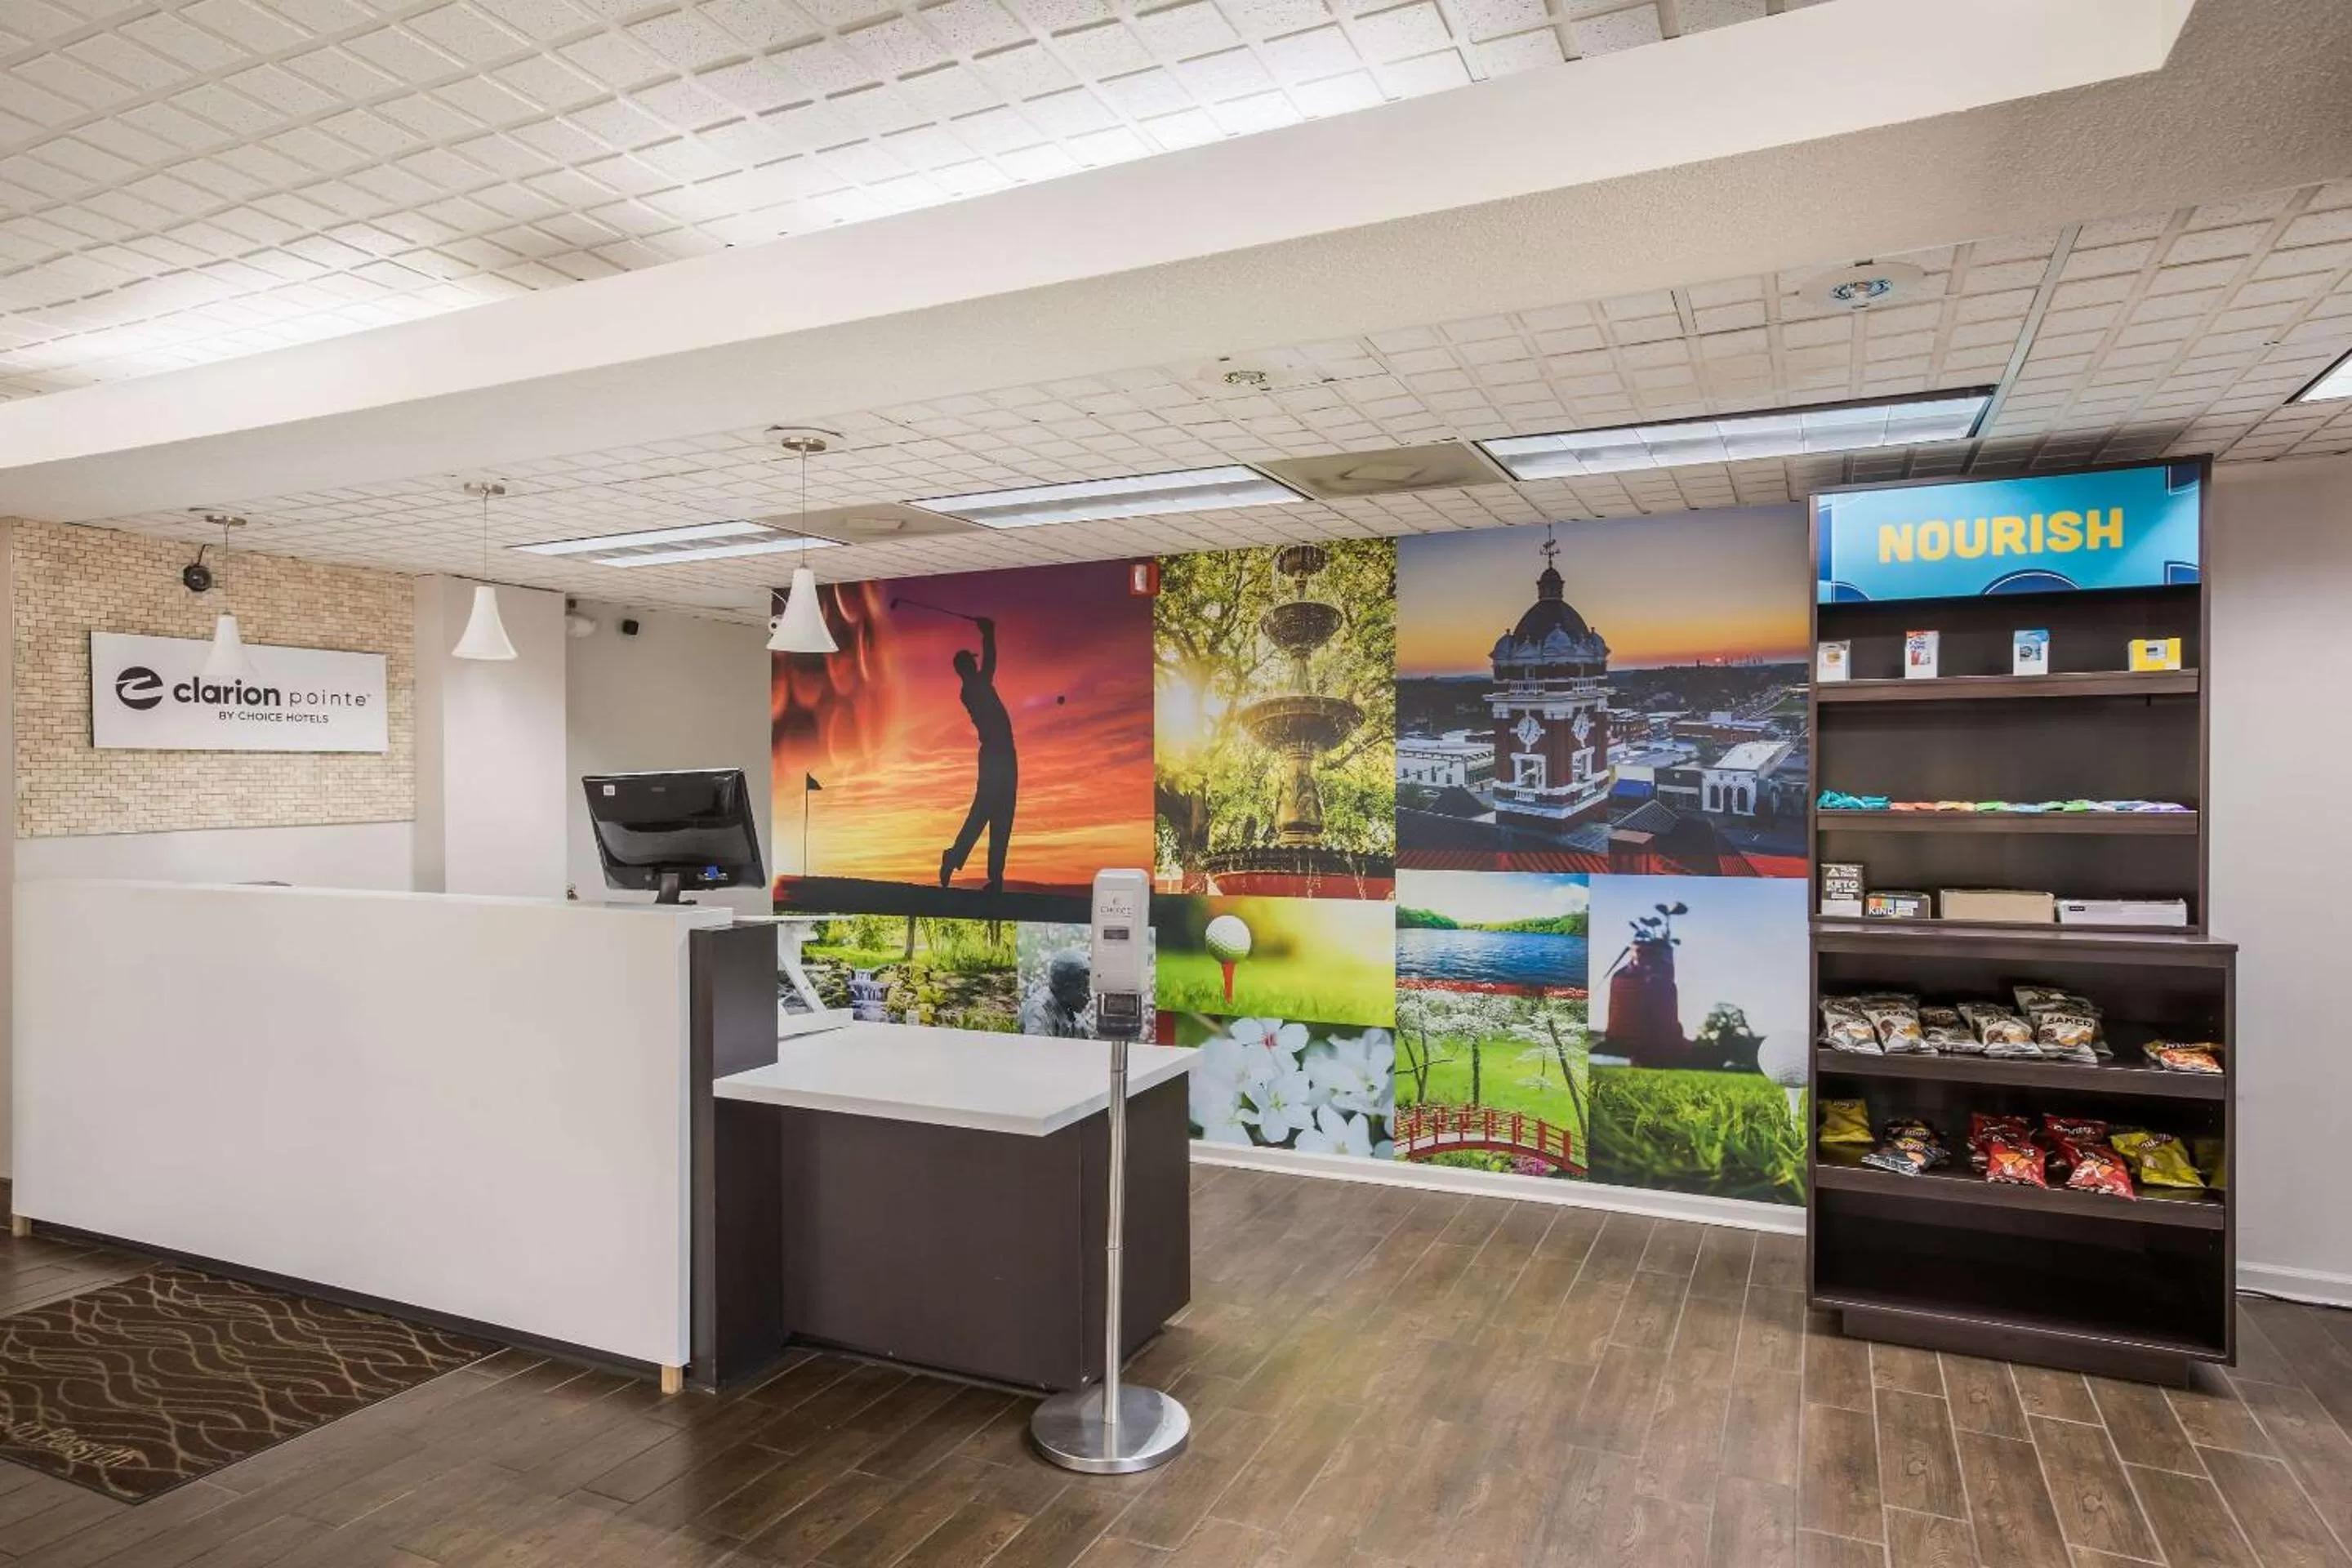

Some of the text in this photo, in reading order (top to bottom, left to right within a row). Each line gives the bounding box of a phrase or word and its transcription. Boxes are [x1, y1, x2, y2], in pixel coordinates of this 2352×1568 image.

[1879, 507, 2123, 564] NOURISH
[173, 676, 367, 707] clarion pointe
[219, 710, 329, 724] BY CHOICE HOTELS
